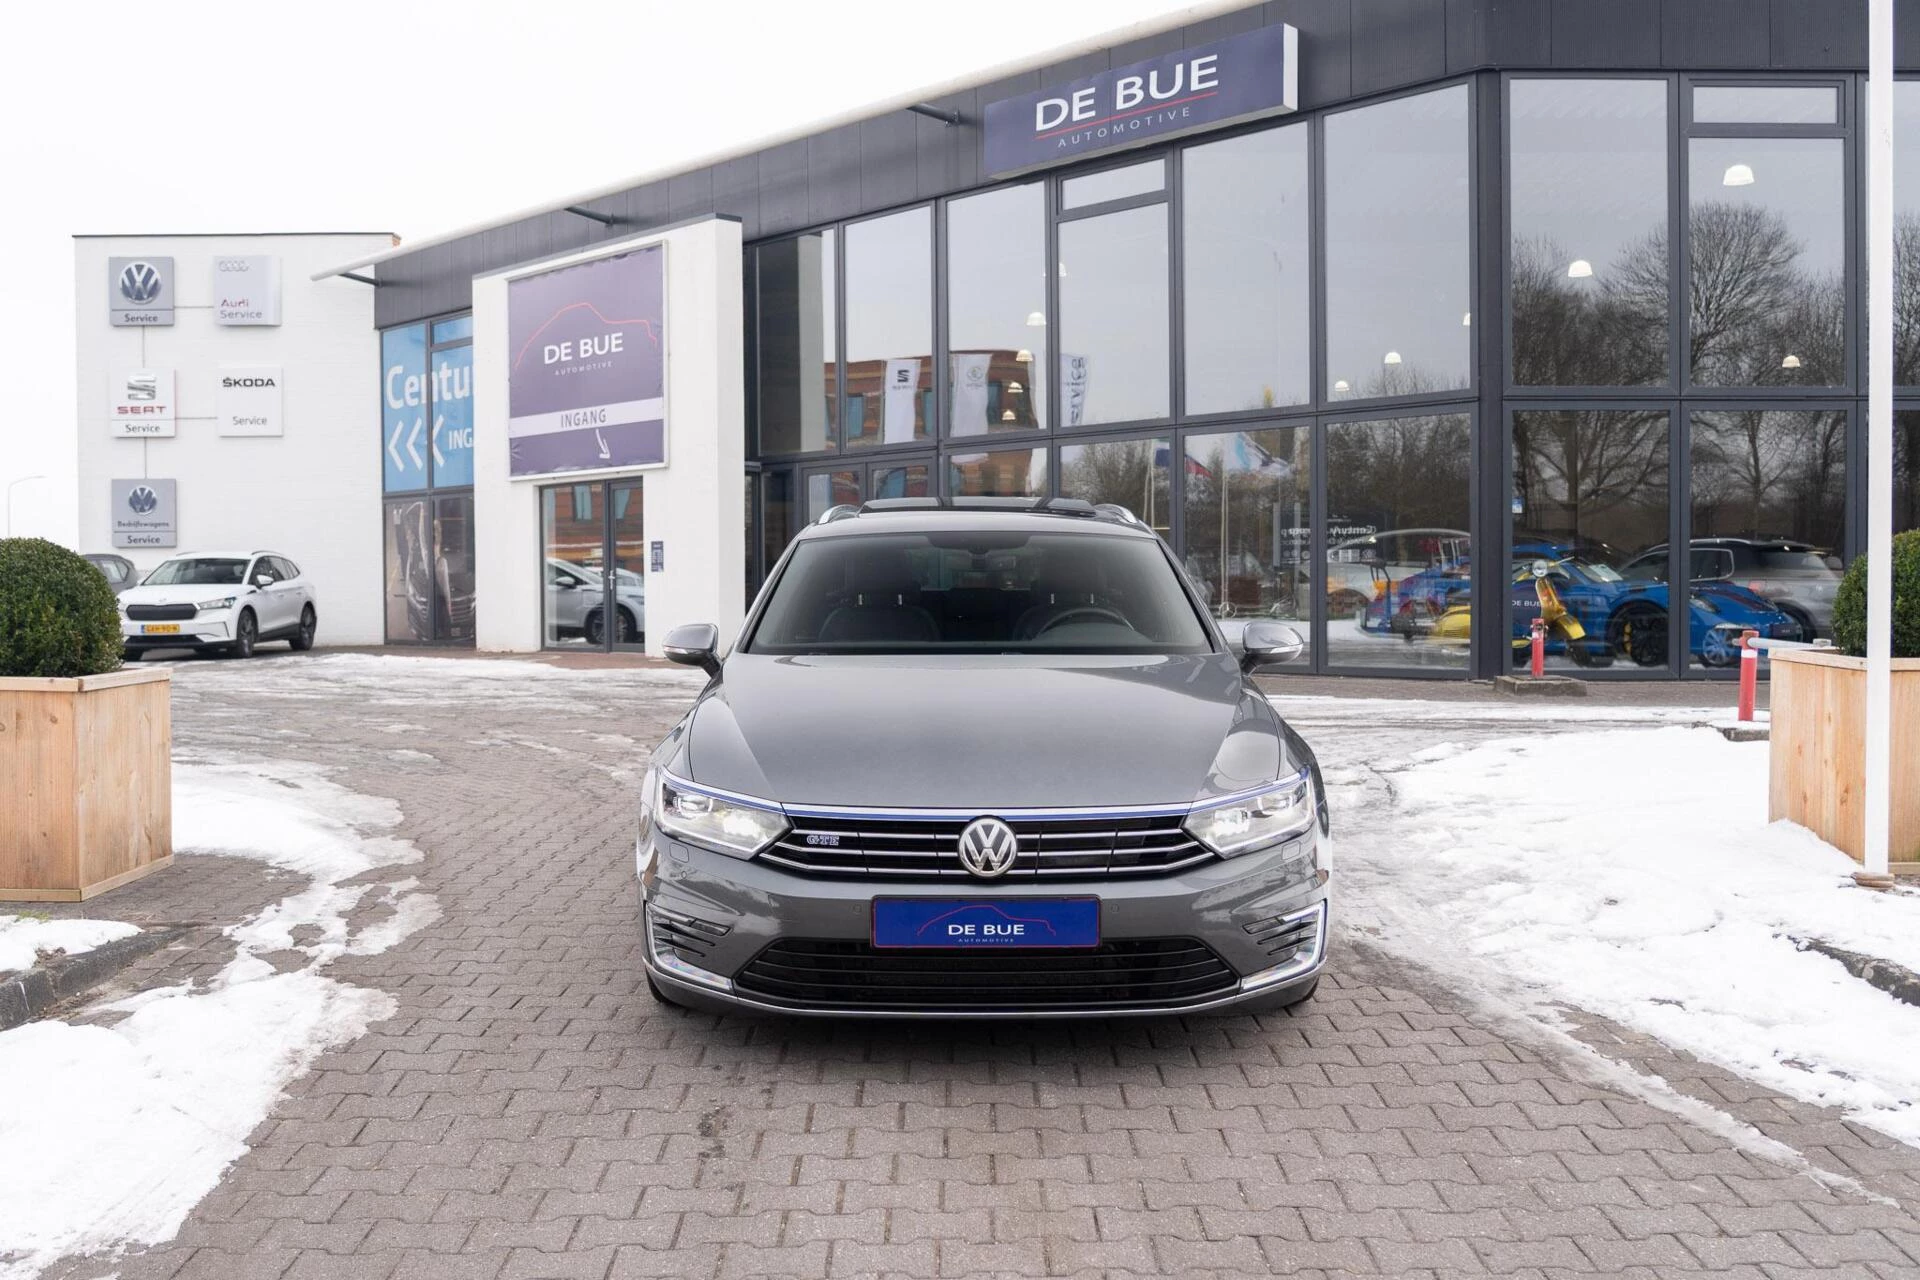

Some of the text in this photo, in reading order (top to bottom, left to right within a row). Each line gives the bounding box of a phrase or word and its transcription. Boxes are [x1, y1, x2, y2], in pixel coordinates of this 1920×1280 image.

[1035, 54, 1219, 131] DE BUE
[1057, 107, 1190, 148] AUTOMOTIVE
[221, 299, 249, 308] Audi
[124, 313, 158, 323] Service
[220, 310, 263, 320] Service
[544, 332, 624, 364] DE BUE
[555, 361, 612, 376] AUTOMOTIVE
[223, 377, 275, 388] ŠKODA
[386, 361, 473, 409] Centu
[117, 406, 166, 415] SEAT
[232, 416, 268, 426] Service
[561, 408, 607, 428] INGANG
[125, 424, 161, 434] Service
[449, 428, 473, 450] ING
[127, 535, 161, 544] Service
[806, 834, 840, 846] GTE
[948, 924, 1025, 935] DE BUE
